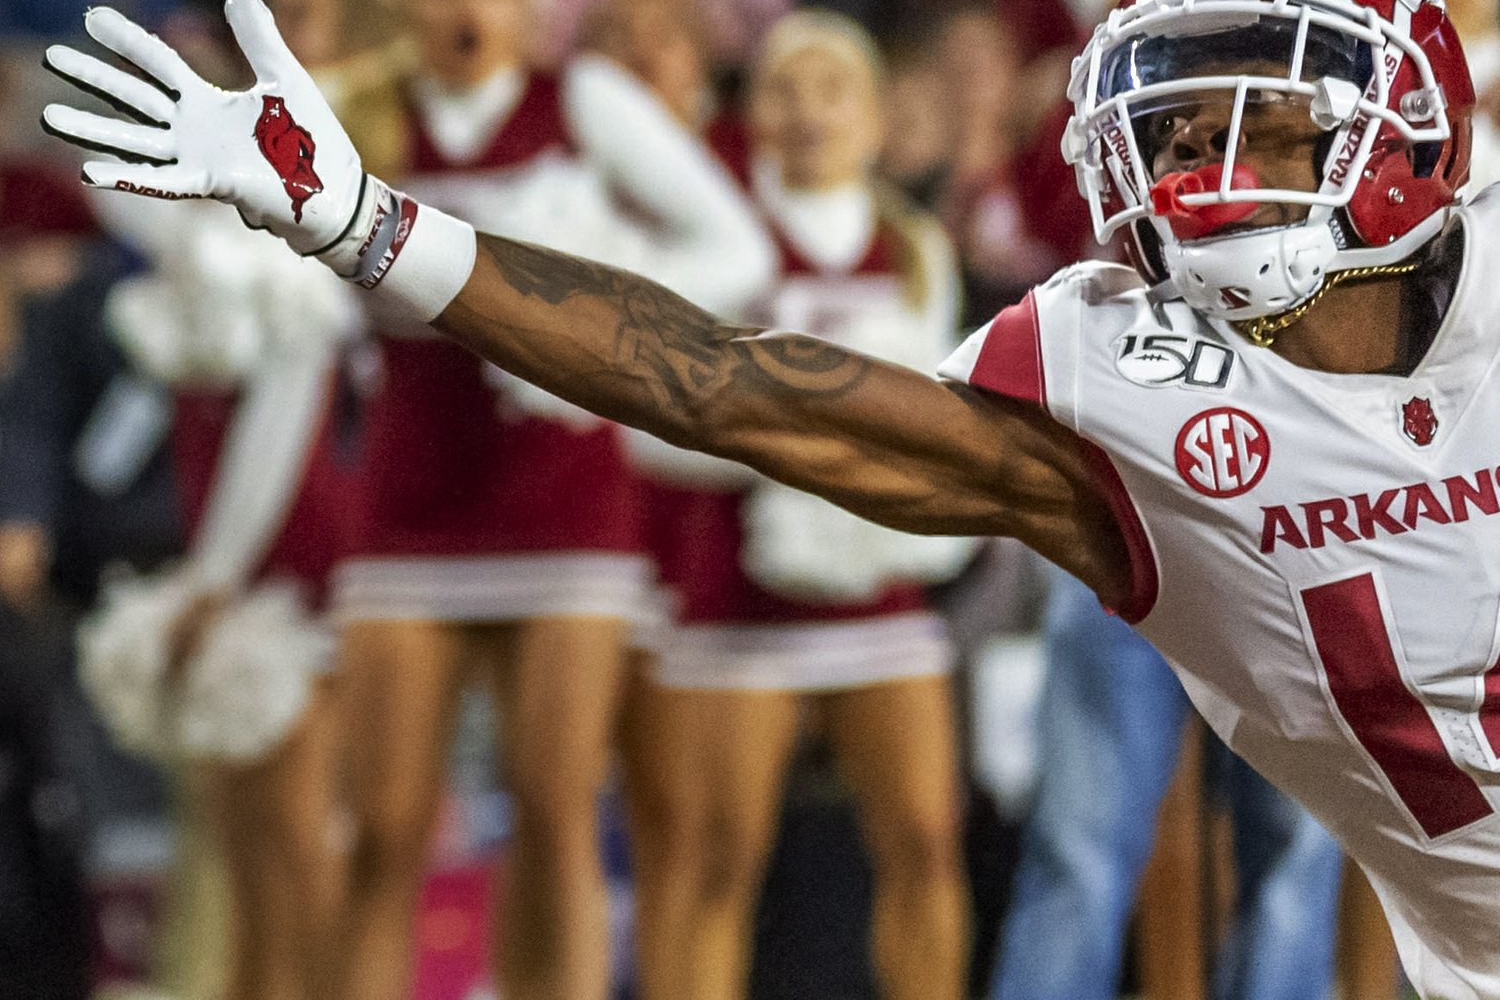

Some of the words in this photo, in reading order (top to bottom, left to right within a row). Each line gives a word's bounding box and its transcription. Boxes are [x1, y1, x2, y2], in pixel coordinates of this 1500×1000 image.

[1117, 334, 1236, 389] 150
[1183, 412, 1263, 492] SEC
[1259, 463, 1500, 554] ARKAN
